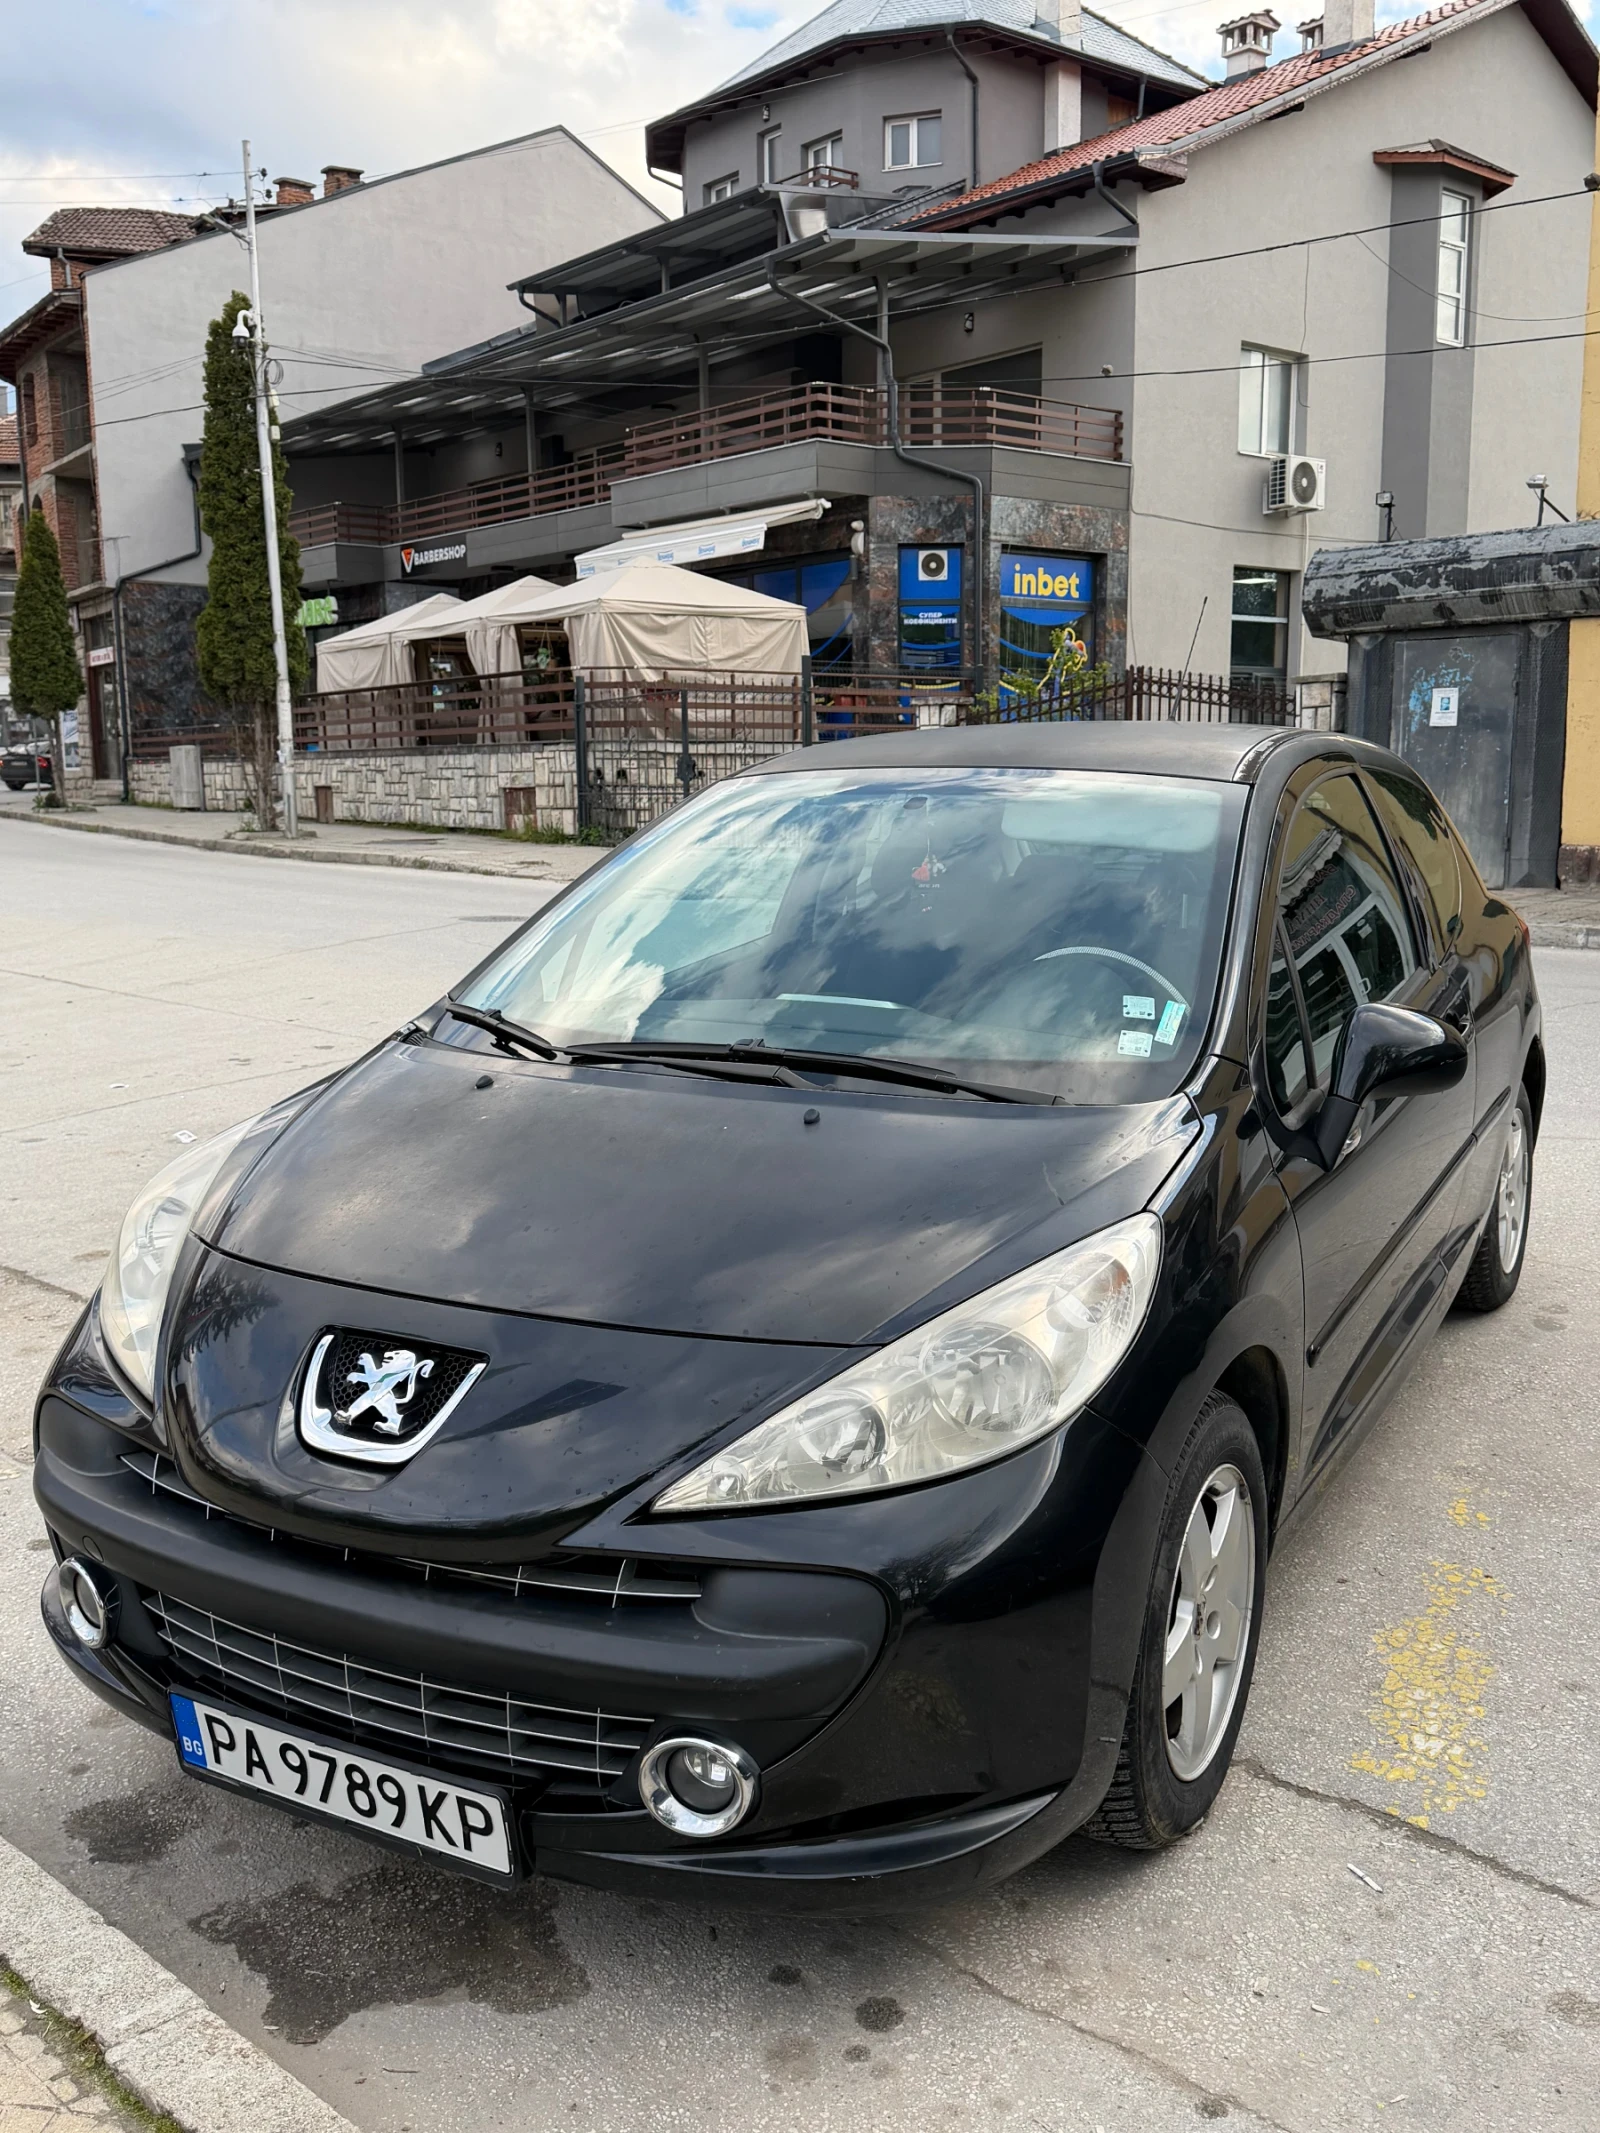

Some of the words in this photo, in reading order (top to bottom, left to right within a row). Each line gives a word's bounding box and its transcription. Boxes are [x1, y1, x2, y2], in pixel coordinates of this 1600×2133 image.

[414, 544, 466, 566] BARBERSHOP
[1014, 563, 1080, 598] inbet
[182, 1736, 203, 1756] BG
[204, 1713, 494, 1852] PA9789KP
